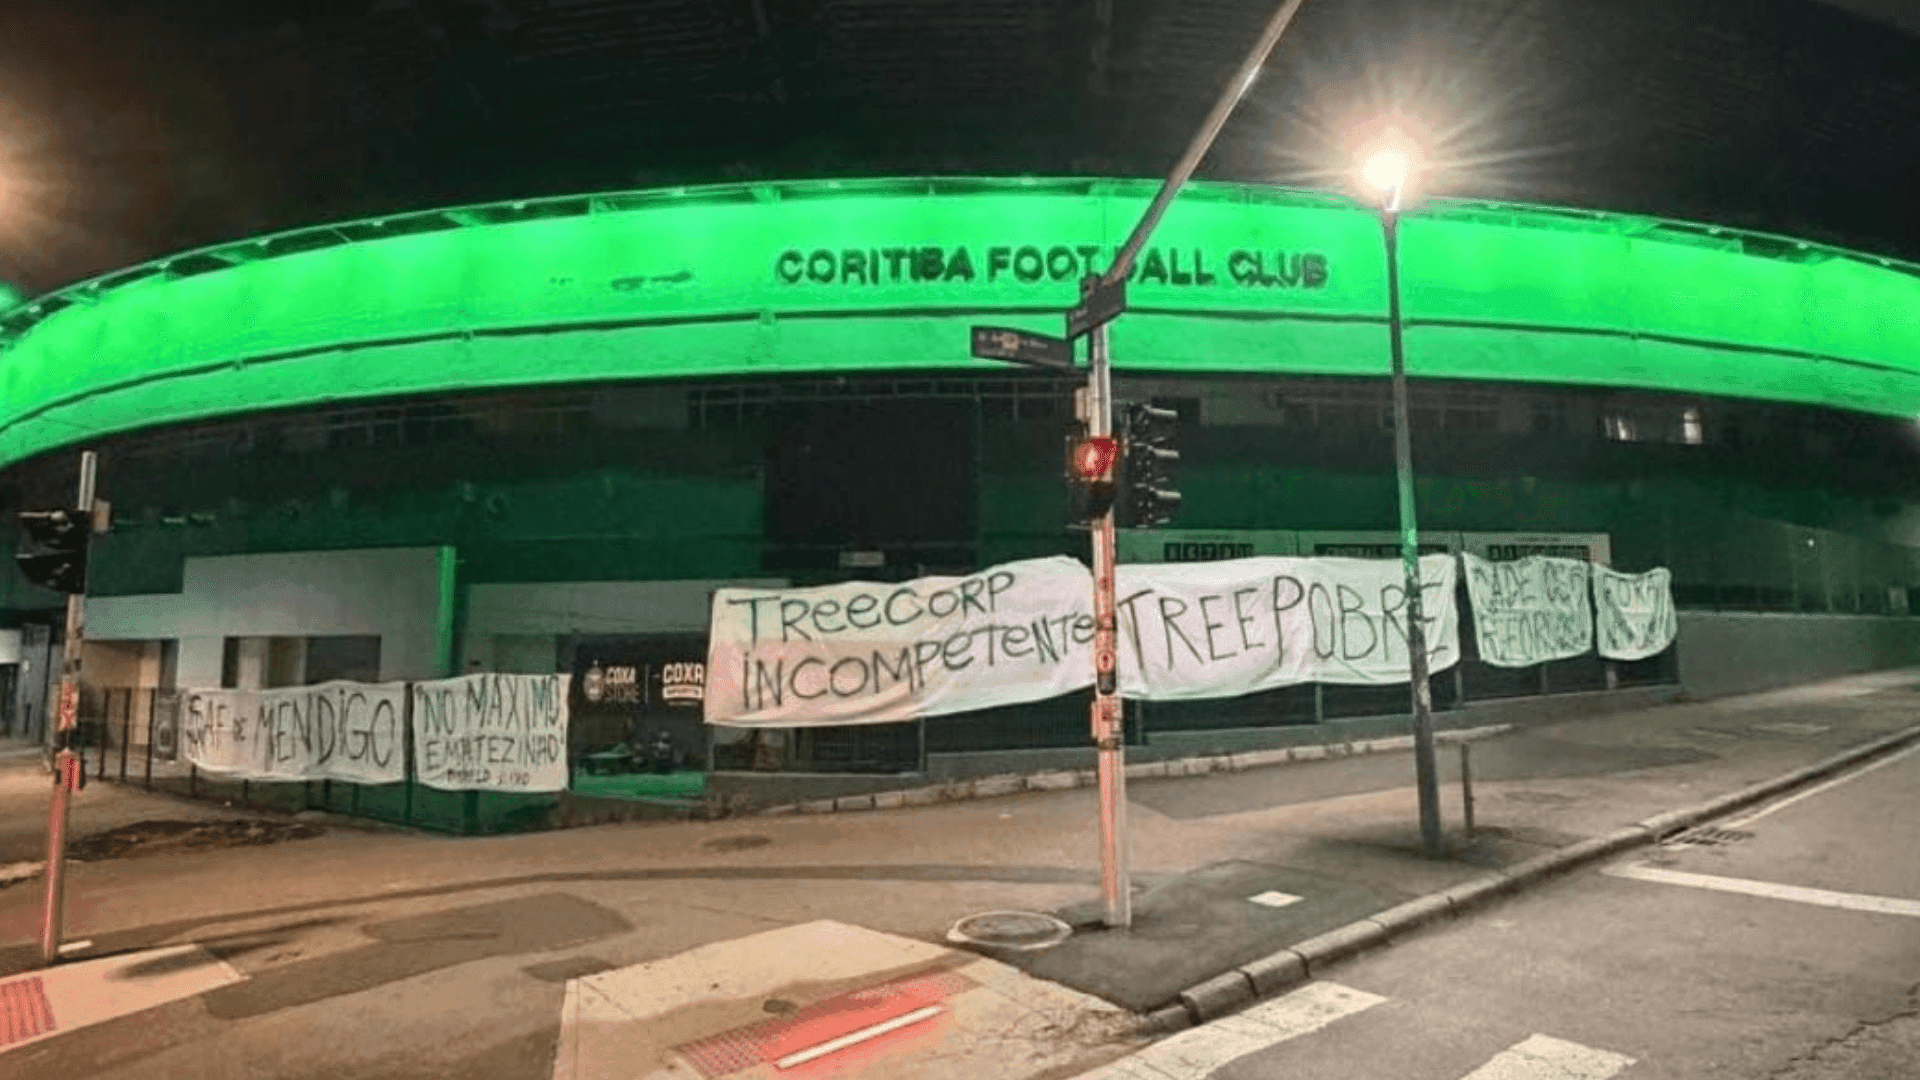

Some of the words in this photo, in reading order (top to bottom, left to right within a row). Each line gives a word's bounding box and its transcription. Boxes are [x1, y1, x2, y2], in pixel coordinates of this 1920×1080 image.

[776, 246, 976, 284] CORITIBA
[1228, 249, 1329, 290] CLUB
[1117, 575, 1449, 671] TREEPOBRE
[606, 666, 636, 684] COXA
[663, 662, 704, 684] COXA
